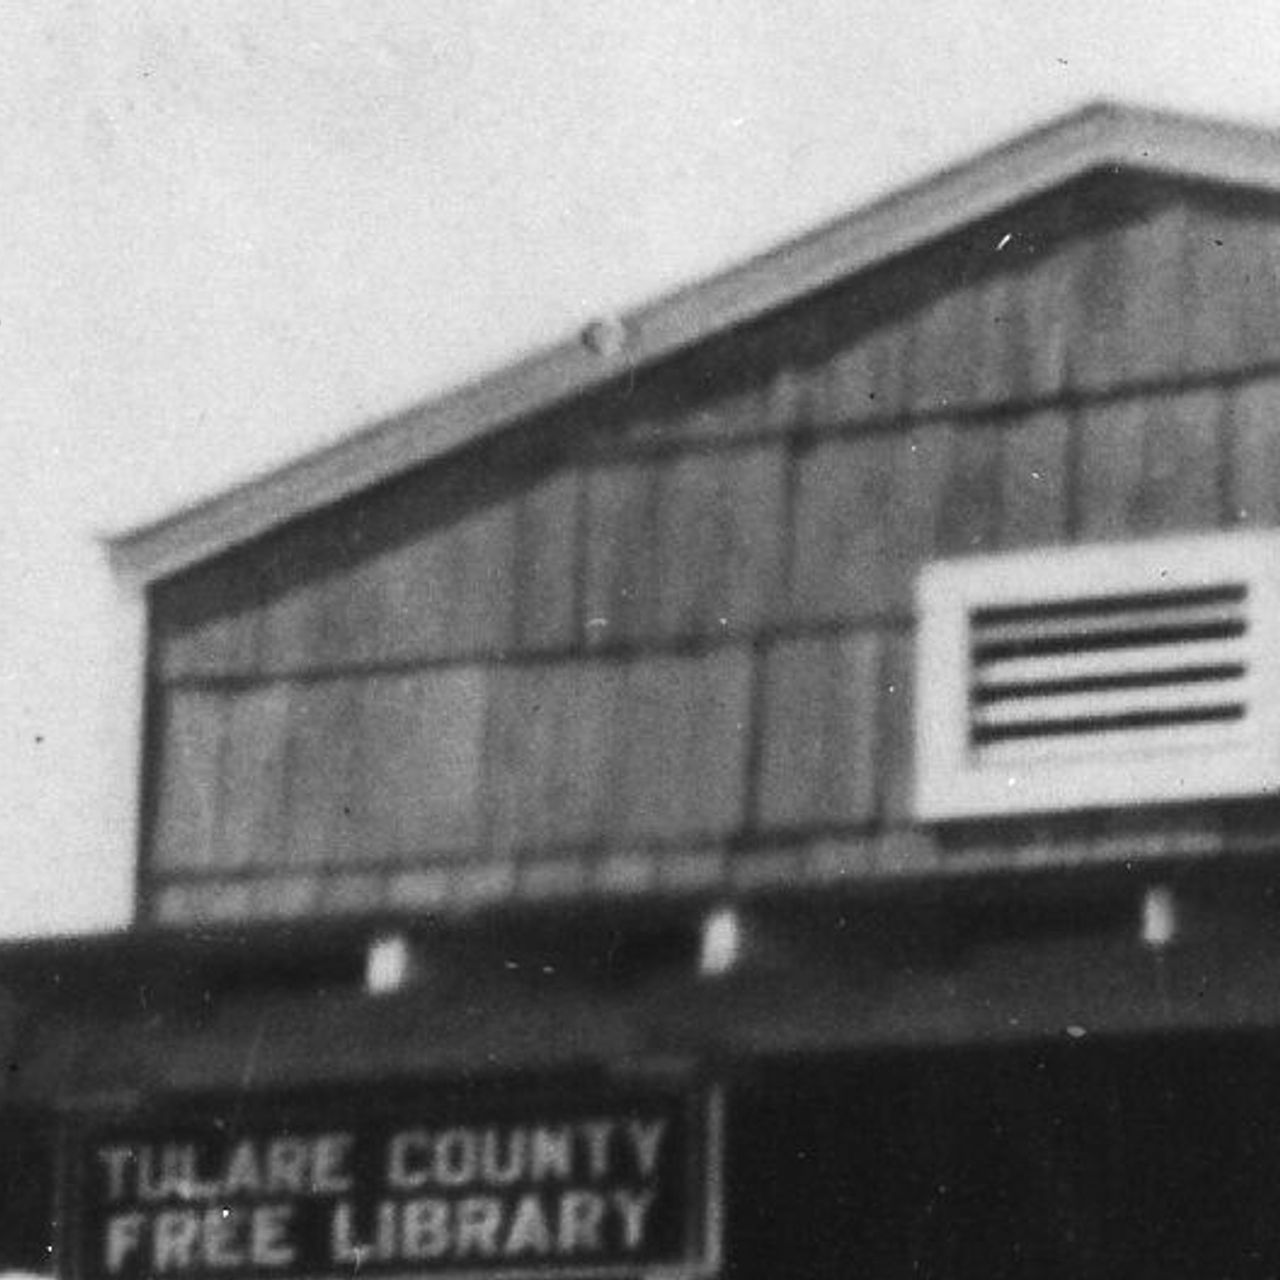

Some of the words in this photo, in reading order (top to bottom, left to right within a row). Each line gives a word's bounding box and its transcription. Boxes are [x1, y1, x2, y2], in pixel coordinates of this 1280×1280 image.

[99, 1134, 354, 1199] TULARE
[389, 1119, 666, 1187] COUNTY
[105, 1205, 295, 1273] FREE
[330, 1192, 654, 1263] LIBRARY
